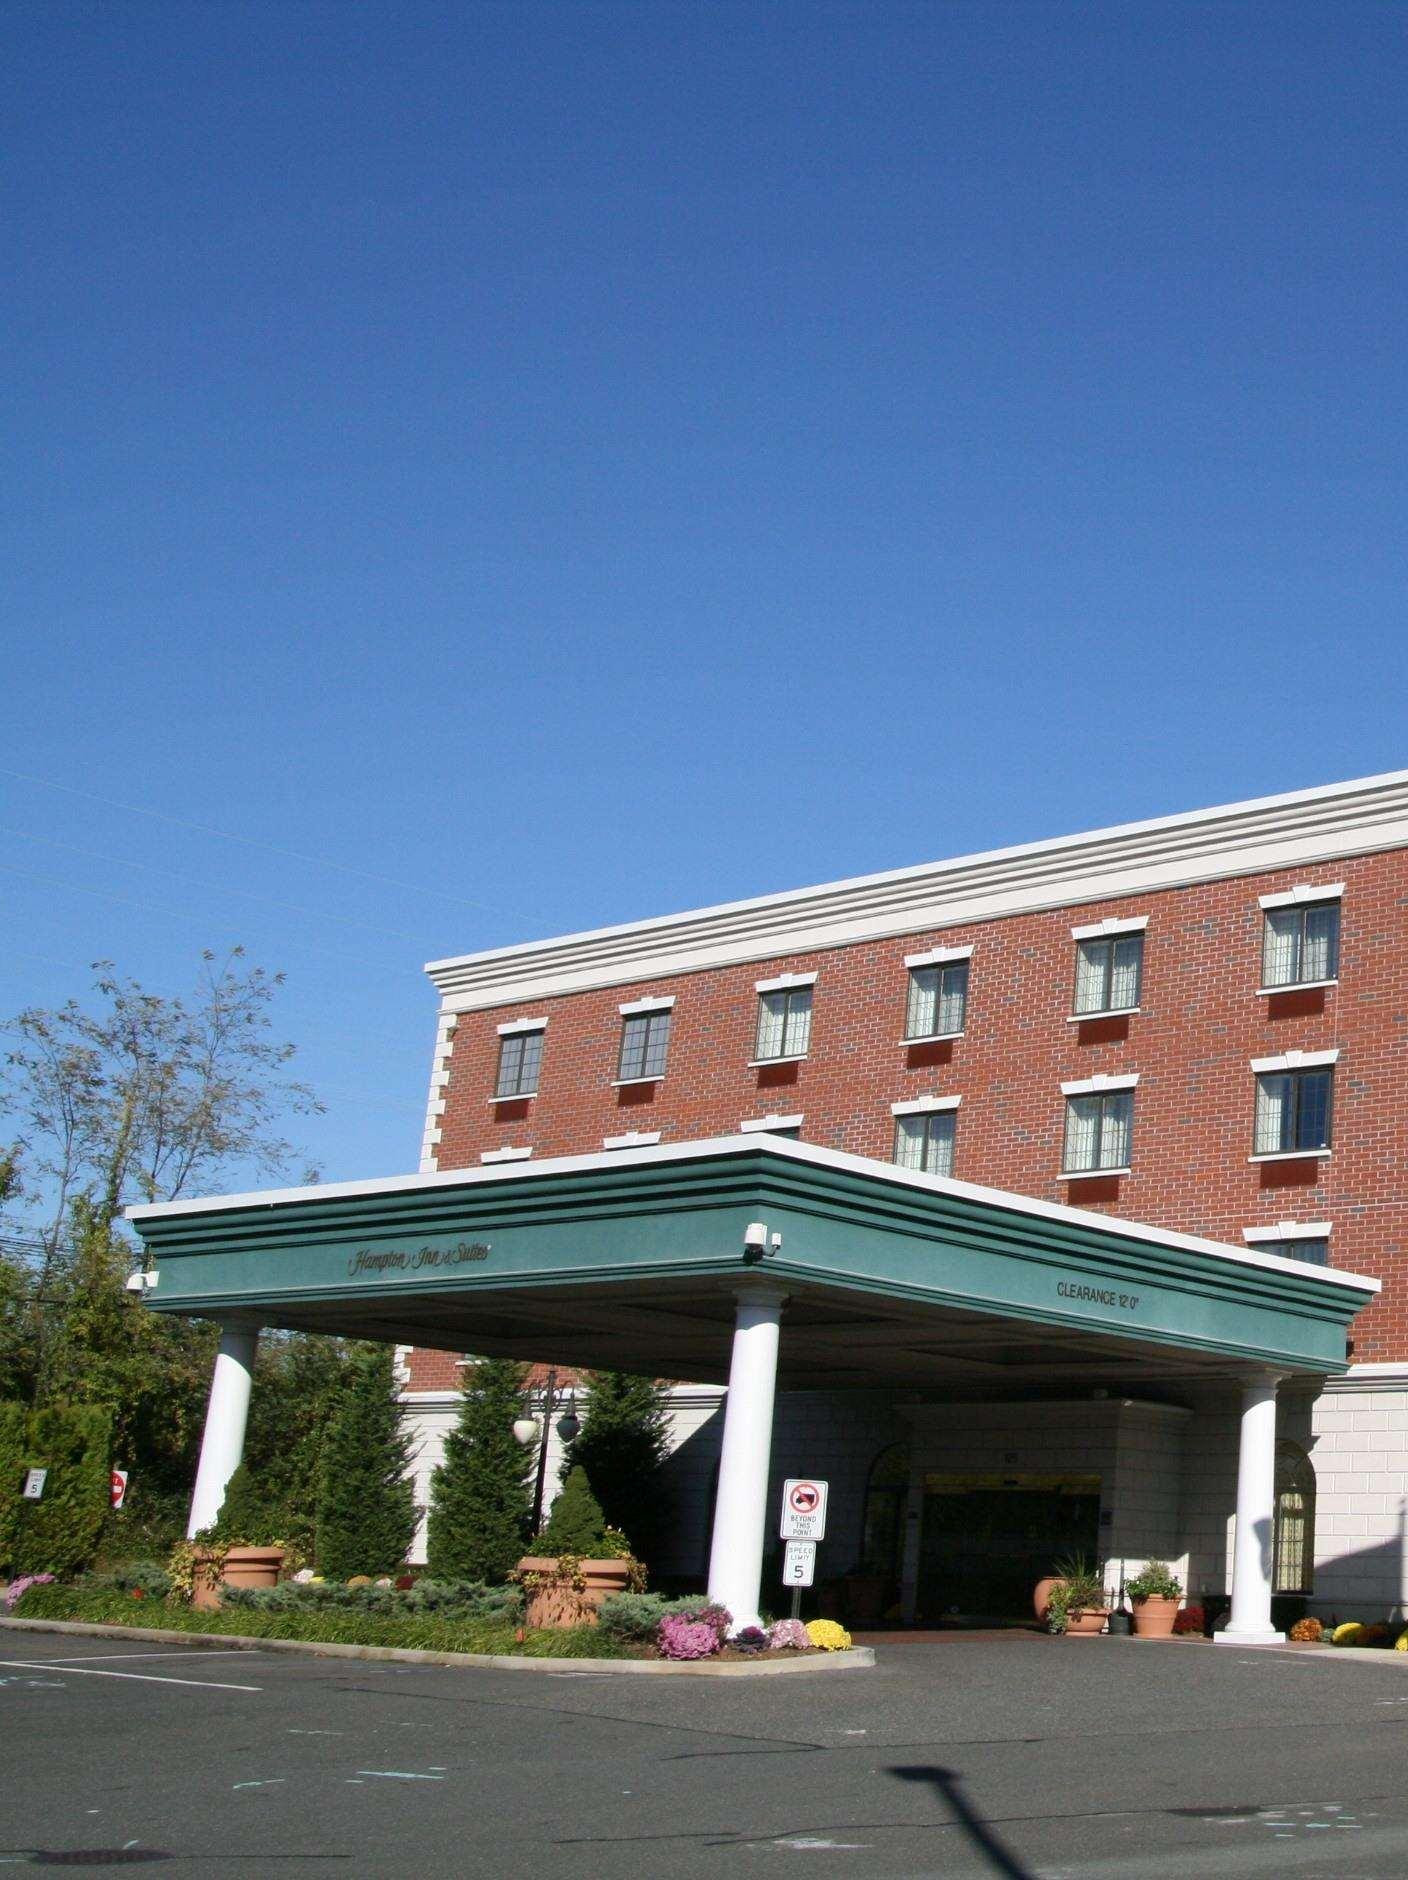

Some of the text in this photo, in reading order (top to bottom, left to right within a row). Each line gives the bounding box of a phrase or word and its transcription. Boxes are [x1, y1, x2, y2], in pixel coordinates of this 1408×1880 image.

[348, 1250, 411, 1277] Hampton
[411, 1246, 442, 1268] Inn
[452, 1242, 488, 1264] Suites
[1057, 1282, 1116, 1305] CLEARANCE
[30, 1484, 37, 1494] 5
[796, 1522, 811, 1530] THIS
[792, 1529, 812, 1537] POINT
[793, 1565, 804, 1579] 5
